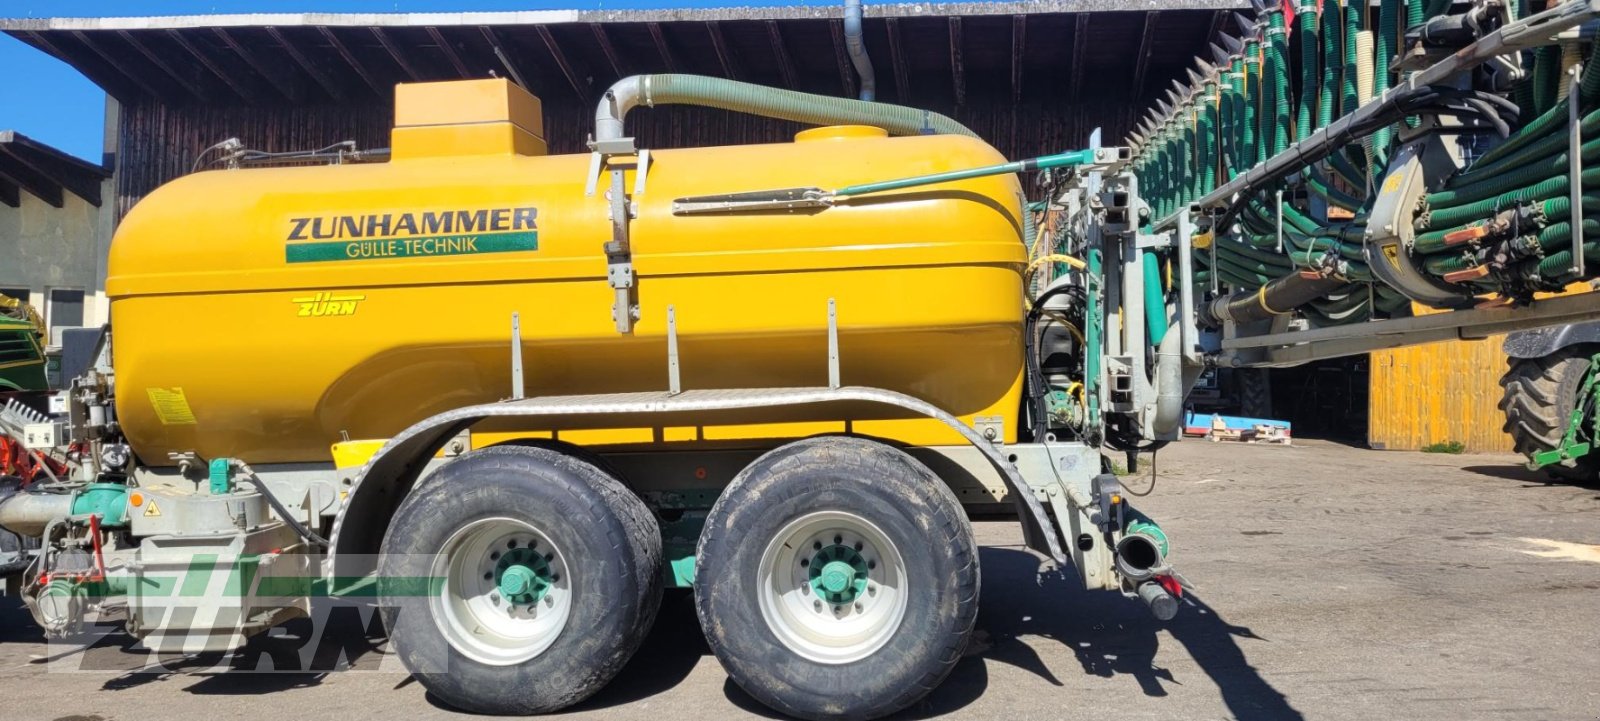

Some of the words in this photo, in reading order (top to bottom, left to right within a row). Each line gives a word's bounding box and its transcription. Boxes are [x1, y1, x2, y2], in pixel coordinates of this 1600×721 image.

[287, 207, 538, 241] ZUNHAMMER
[346, 236, 478, 258] GÜLLE-TECHNIK
[292, 291, 366, 317] ZÜRN
